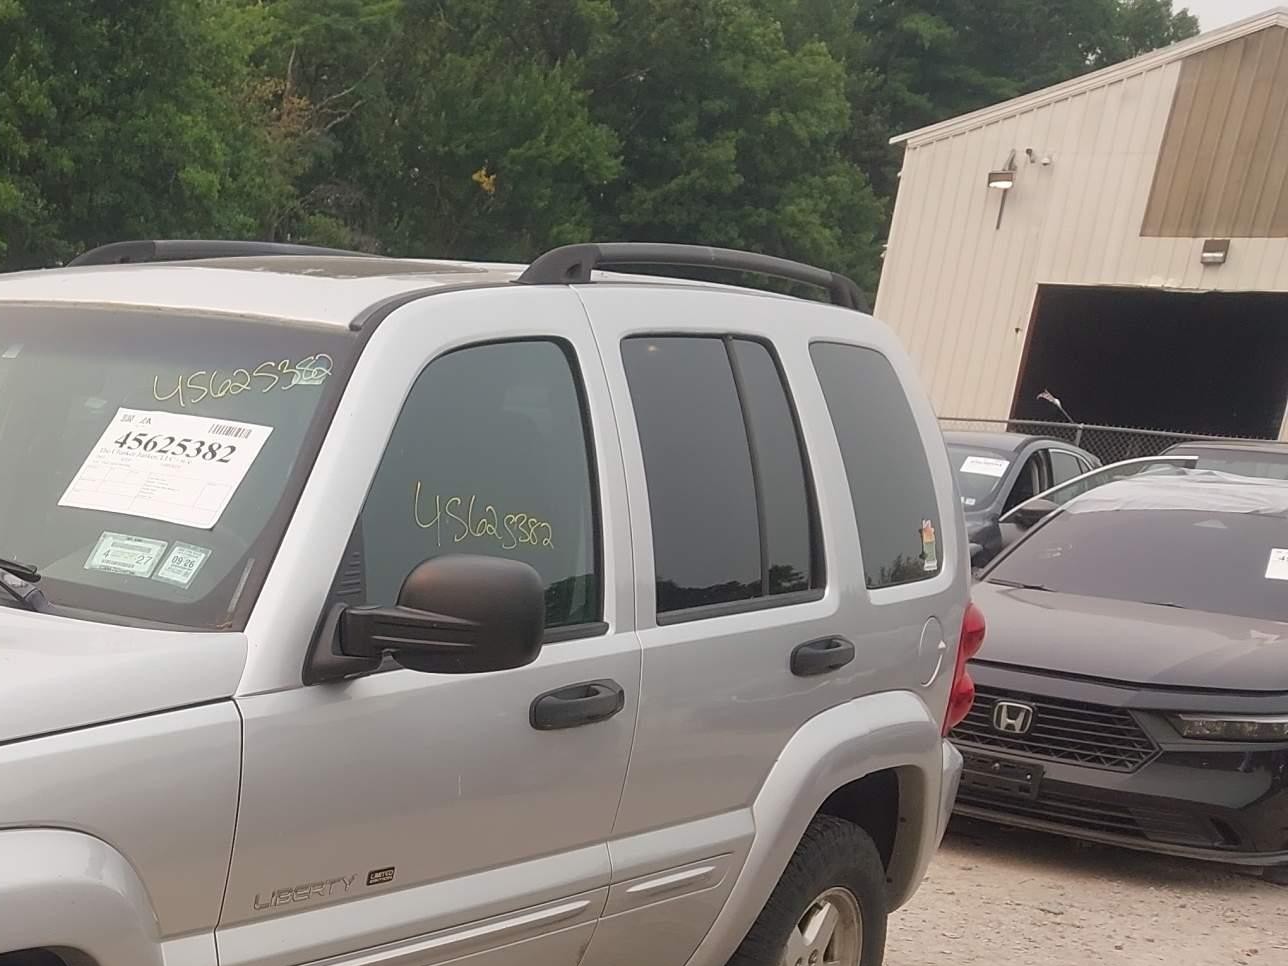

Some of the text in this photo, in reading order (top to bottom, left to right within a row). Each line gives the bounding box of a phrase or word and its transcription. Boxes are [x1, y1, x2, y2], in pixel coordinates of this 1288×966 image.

[153, 353, 334, 407] 45625382
[114, 431, 237, 464] 45625382
[414, 481, 555, 549] 45625382
[135, 555, 153, 566] 27
[253, 873, 358, 910] LIBERTY
